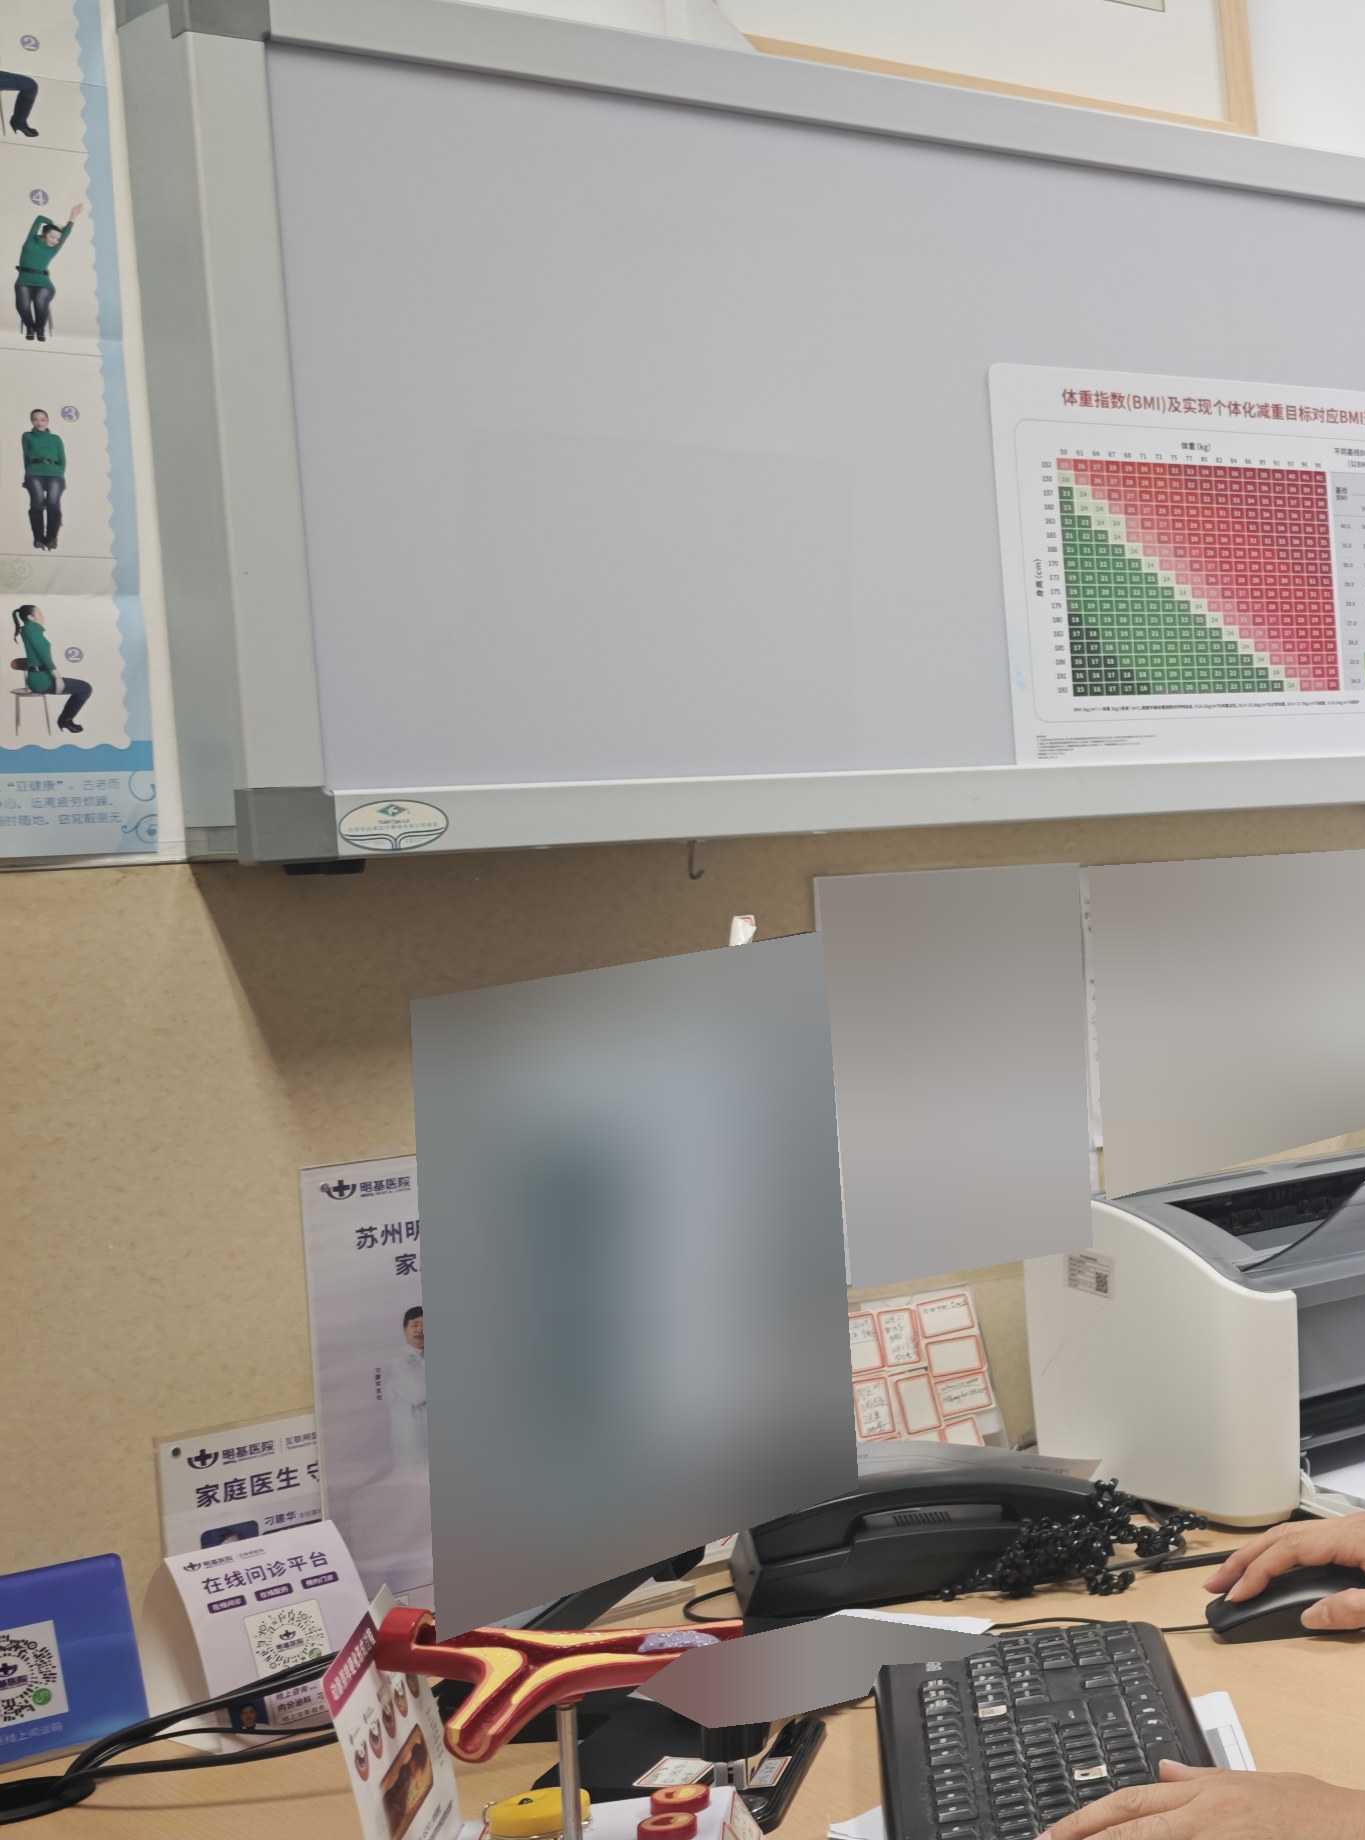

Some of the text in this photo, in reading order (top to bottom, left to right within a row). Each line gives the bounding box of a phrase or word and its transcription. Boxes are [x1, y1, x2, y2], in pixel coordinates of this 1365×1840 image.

[24, 37, 36, 49] 2
[33, 192, 44, 204] 4
[65, 408, 77, 420] 3
[69, 649, 80, 661] 2
[360, 1176, 411, 1192] 明基医院
[395, 1253, 421, 1275] 家
[222, 1441, 274, 1460] 明基医院
[196, 1466, 300, 1508] 家庭医生
[202, 1551, 328, 1594] 在线问诊平台
